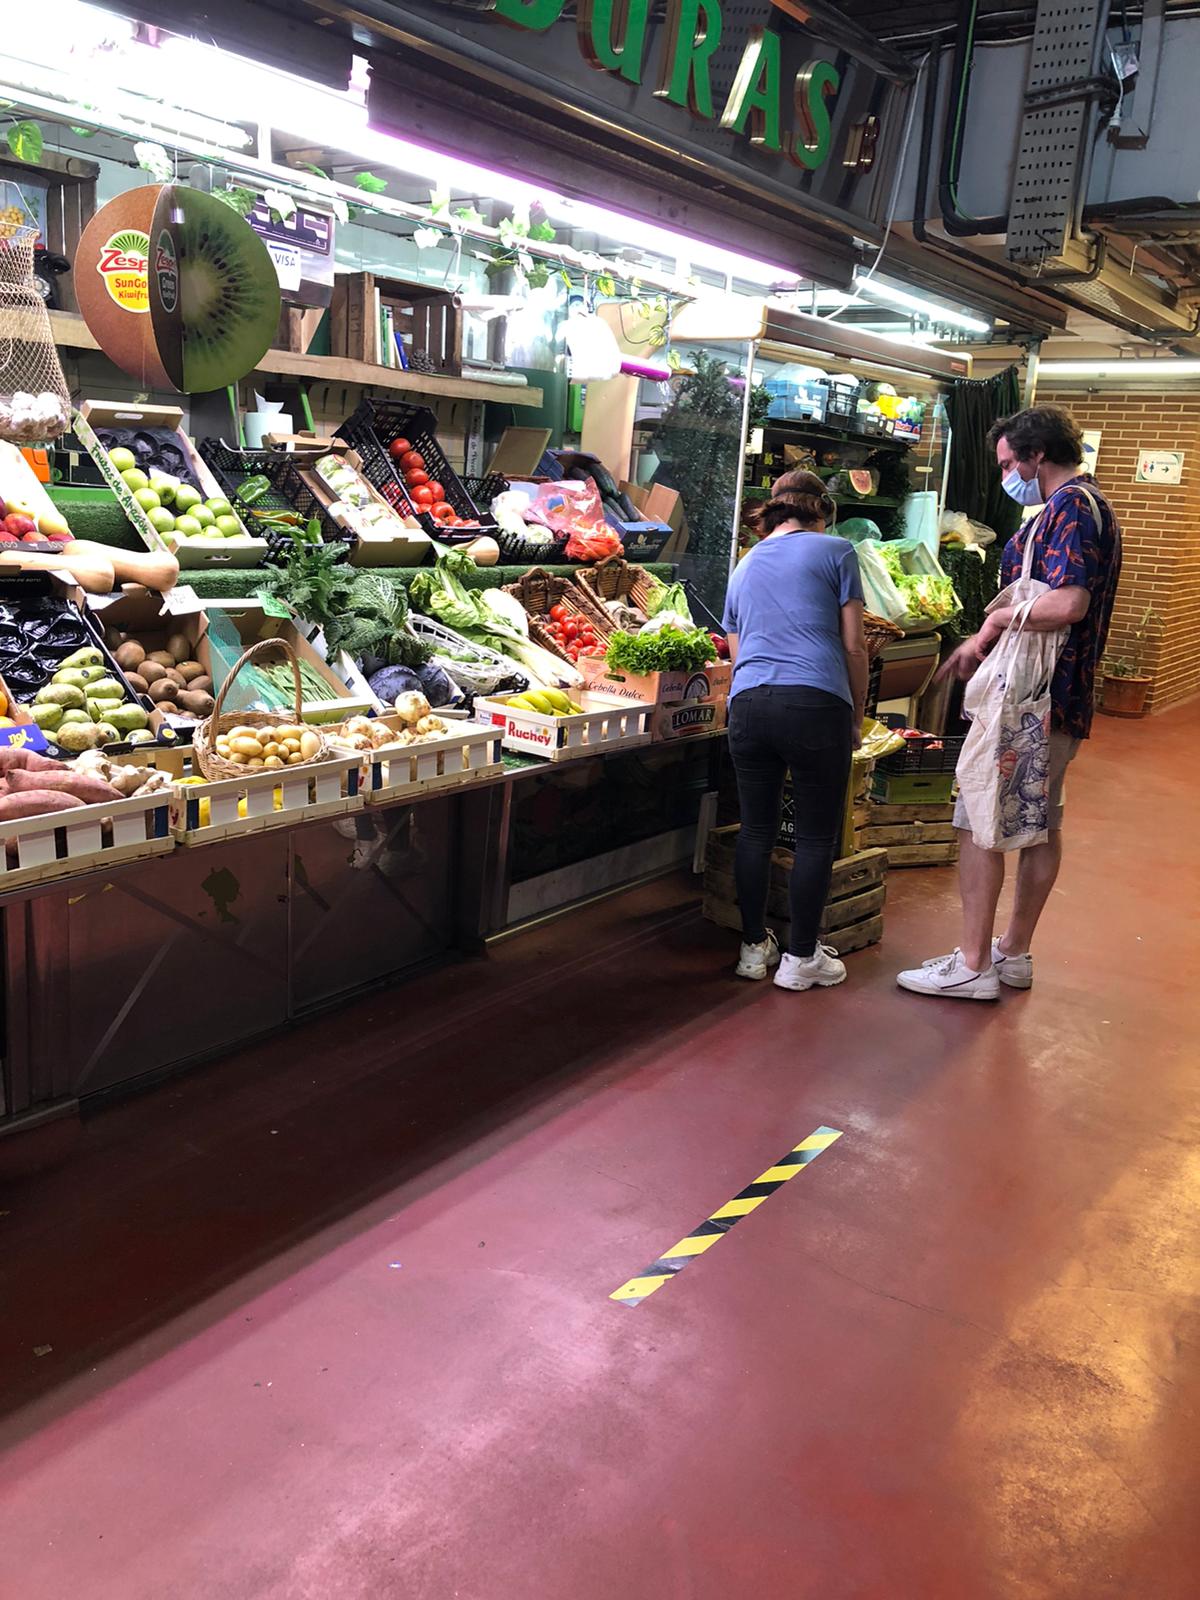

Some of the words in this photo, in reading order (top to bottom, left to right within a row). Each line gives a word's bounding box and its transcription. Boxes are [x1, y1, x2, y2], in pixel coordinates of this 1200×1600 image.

[274, 253, 296, 267] VISA
[91, 442, 115, 480] Frutas
[112, 478, 123, 496] de
[589, 679, 617, 694] Cebolla
[619, 687, 644, 699] Dulce
[676, 709, 711, 726] LOMAR
[508, 721, 551, 746] Ruchey
